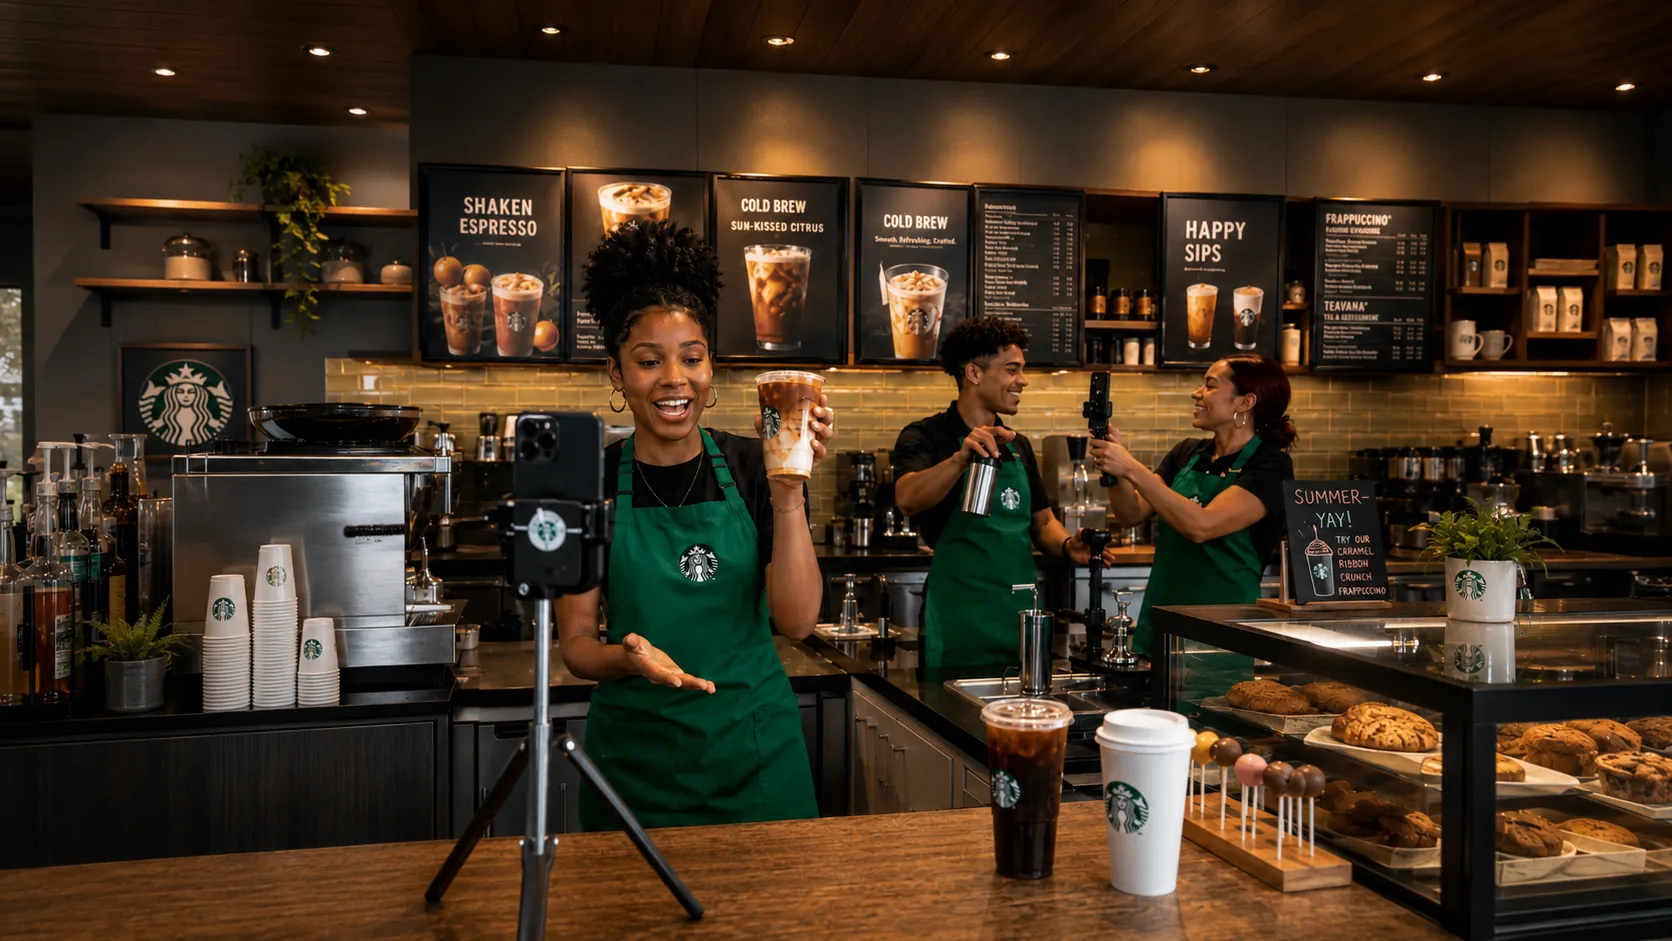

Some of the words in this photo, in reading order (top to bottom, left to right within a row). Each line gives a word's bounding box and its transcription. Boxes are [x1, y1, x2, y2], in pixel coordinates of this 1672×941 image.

[463, 196, 532, 216] SHAKEN
[741, 198, 770, 213] COLD
[773, 199, 806, 214] BREW
[460, 218, 537, 236] ESPRESSO
[730, 220, 788, 232] SUN-KISSED
[790, 222, 824, 233] CITRUS
[883, 213, 913, 229] COLD
[915, 215, 948, 230] BREW
[1185, 220, 1246, 240] HAPPY
[1184, 243, 1222, 262] SIPS
[1294, 489, 1370, 505] SUMMER-
[1316, 510, 1352, 528] YAY!
[1335, 535, 1351, 544] TRY
[1355, 535, 1371, 544] OUR
[1337, 547, 1374, 556] CARAMEL
[1339, 559, 1369, 569] RIBBON
[1340, 572, 1373, 581] CRUNCH
